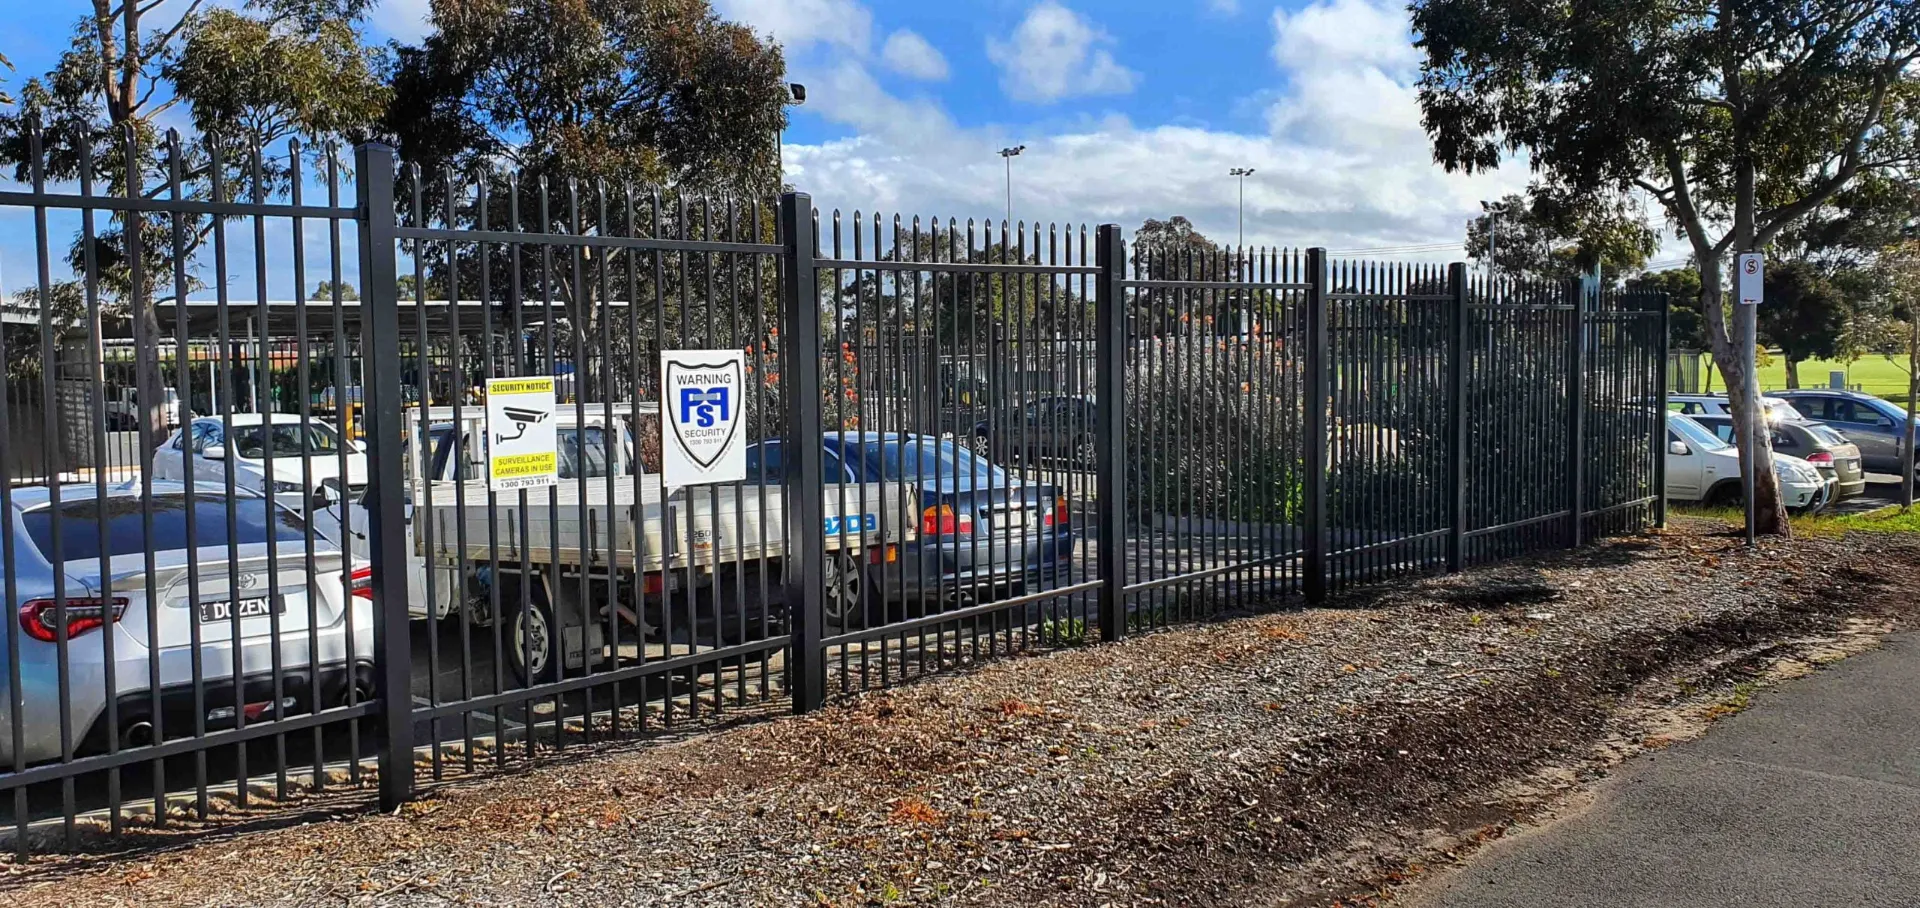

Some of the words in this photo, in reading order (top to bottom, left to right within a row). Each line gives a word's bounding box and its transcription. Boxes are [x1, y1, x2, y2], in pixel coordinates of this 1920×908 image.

[676, 374, 732, 385] WARNING
[492, 383, 525, 393] SECURITY
[526, 382, 551, 391] NOTICE
[684, 428, 727, 438] SECURITY
[498, 454, 550, 466] SURVEILLANCE
[495, 466, 530, 476] CAMERAS
[531, 465, 538, 473] IN
[213, 599, 270, 619] DOZEN
